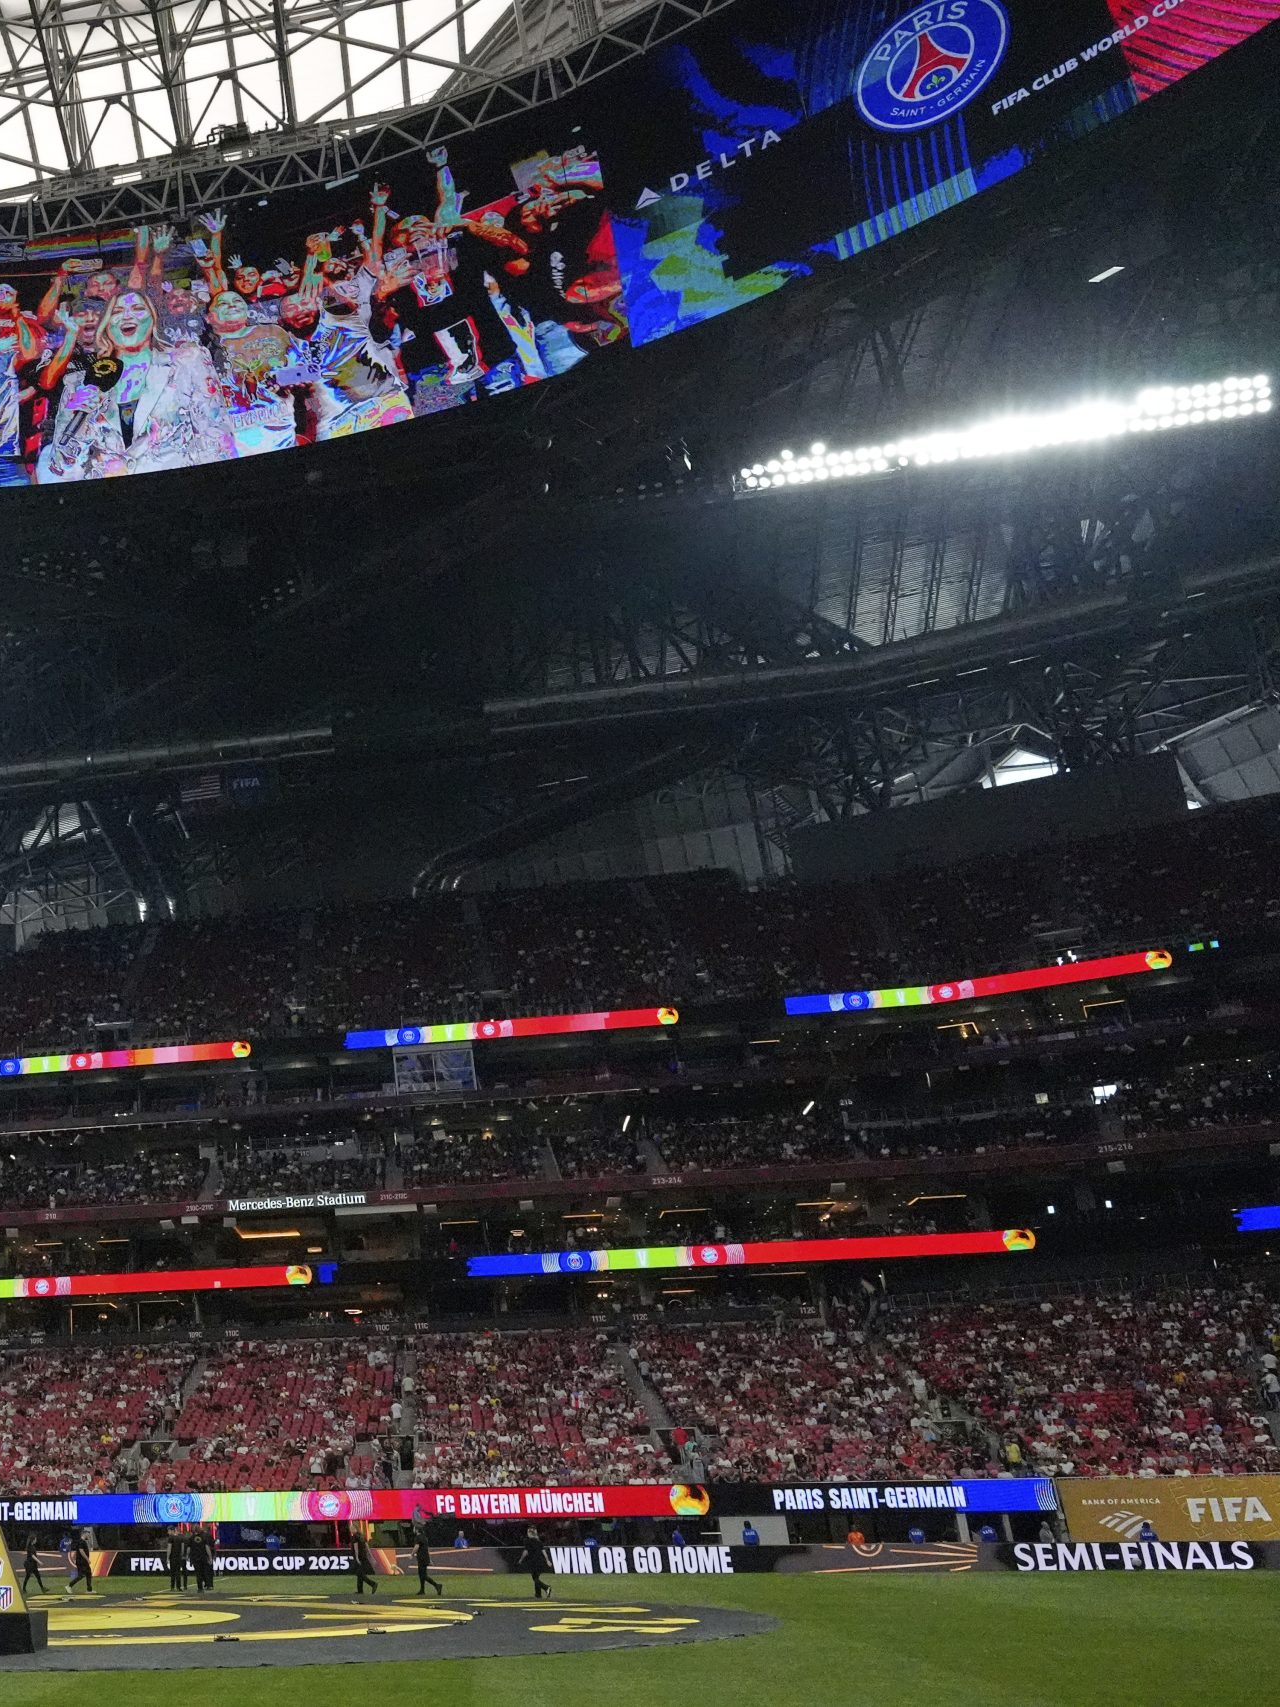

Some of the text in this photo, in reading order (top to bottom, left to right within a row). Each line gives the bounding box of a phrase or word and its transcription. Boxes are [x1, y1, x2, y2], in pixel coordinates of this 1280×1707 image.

[873, 1, 968, 62] PARIS
[991, 0, 1184, 116] FIFA CLUB WORLD CU
[890, 59, 986, 118] SAINT GERMAIN
[669, 129, 782, 193] DELTA
[232, 777, 261, 790] FIFA
[228, 1194, 366, 1212] Mercedes-Benz Stadium
[436, 1489, 604, 1514] FC BAYERN MÜNCHEN
[772, 1486, 967, 1510] PARIS SAINT-GERMAIN
[1186, 1497, 1272, 1523] FIFA
[130, 1556, 164, 1571] FIFA
[213, 1556, 270, 1571] WORLD
[272, 1556, 305, 1571] CUP
[308, 1555, 350, 1571] 2025
[550, 1545, 734, 1574] WIN OR GO HOME
[1013, 1541, 1254, 1572] SEMI-FINALS
